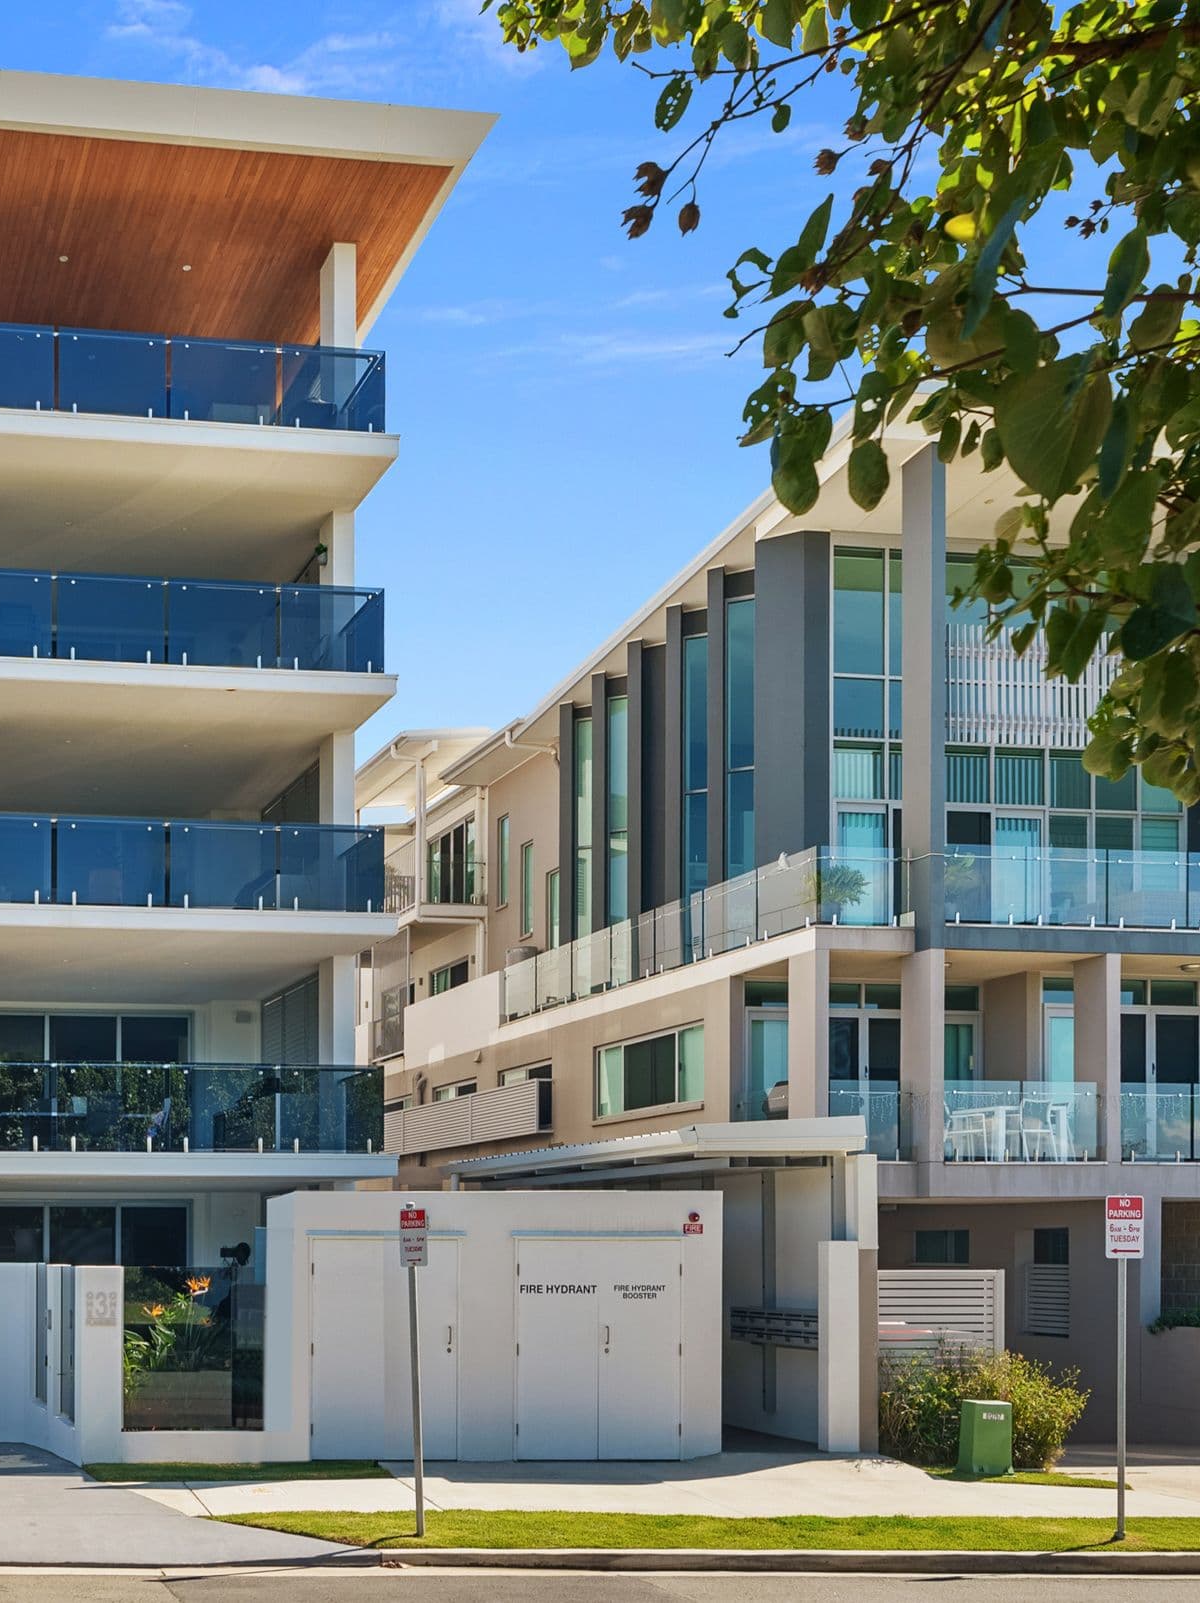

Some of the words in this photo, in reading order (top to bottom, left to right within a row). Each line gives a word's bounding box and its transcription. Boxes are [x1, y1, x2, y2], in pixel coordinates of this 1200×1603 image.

[1119, 1199, 1131, 1207] NO
[408, 1211, 418, 1219] NO
[1108, 1209, 1142, 1218] PARKING
[400, 1219, 425, 1228] PARKING
[684, 1224, 702, 1233] FIRE
[520, 1284, 543, 1294] FIRE
[546, 1284, 598, 1294] HYDRANT
[614, 1284, 630, 1292] FIRE
[631, 1284, 666, 1292] HYDRANT
